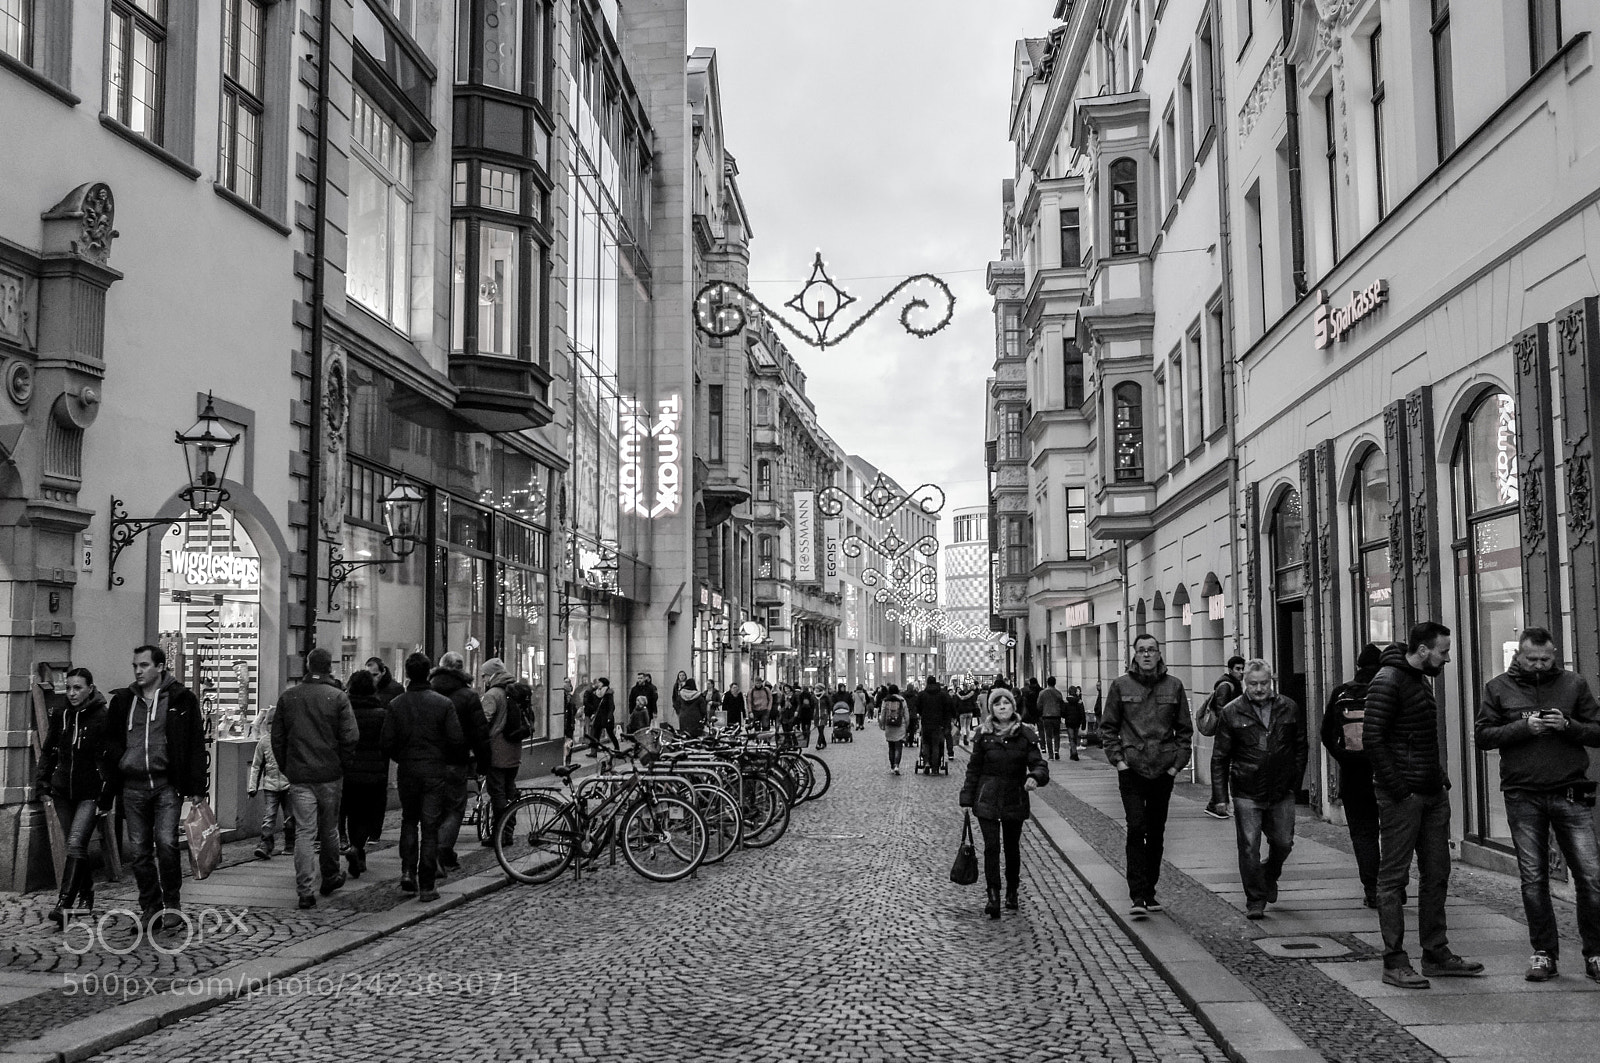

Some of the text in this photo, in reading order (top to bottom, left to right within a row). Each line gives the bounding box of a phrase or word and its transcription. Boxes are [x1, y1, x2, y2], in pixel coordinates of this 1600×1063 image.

[1330, 279, 1381, 342] Sparkasse
[85, 551, 91, 566] 3
[799, 499, 810, 572] ROSSMANN
[827, 536, 837, 577] EGOIST
